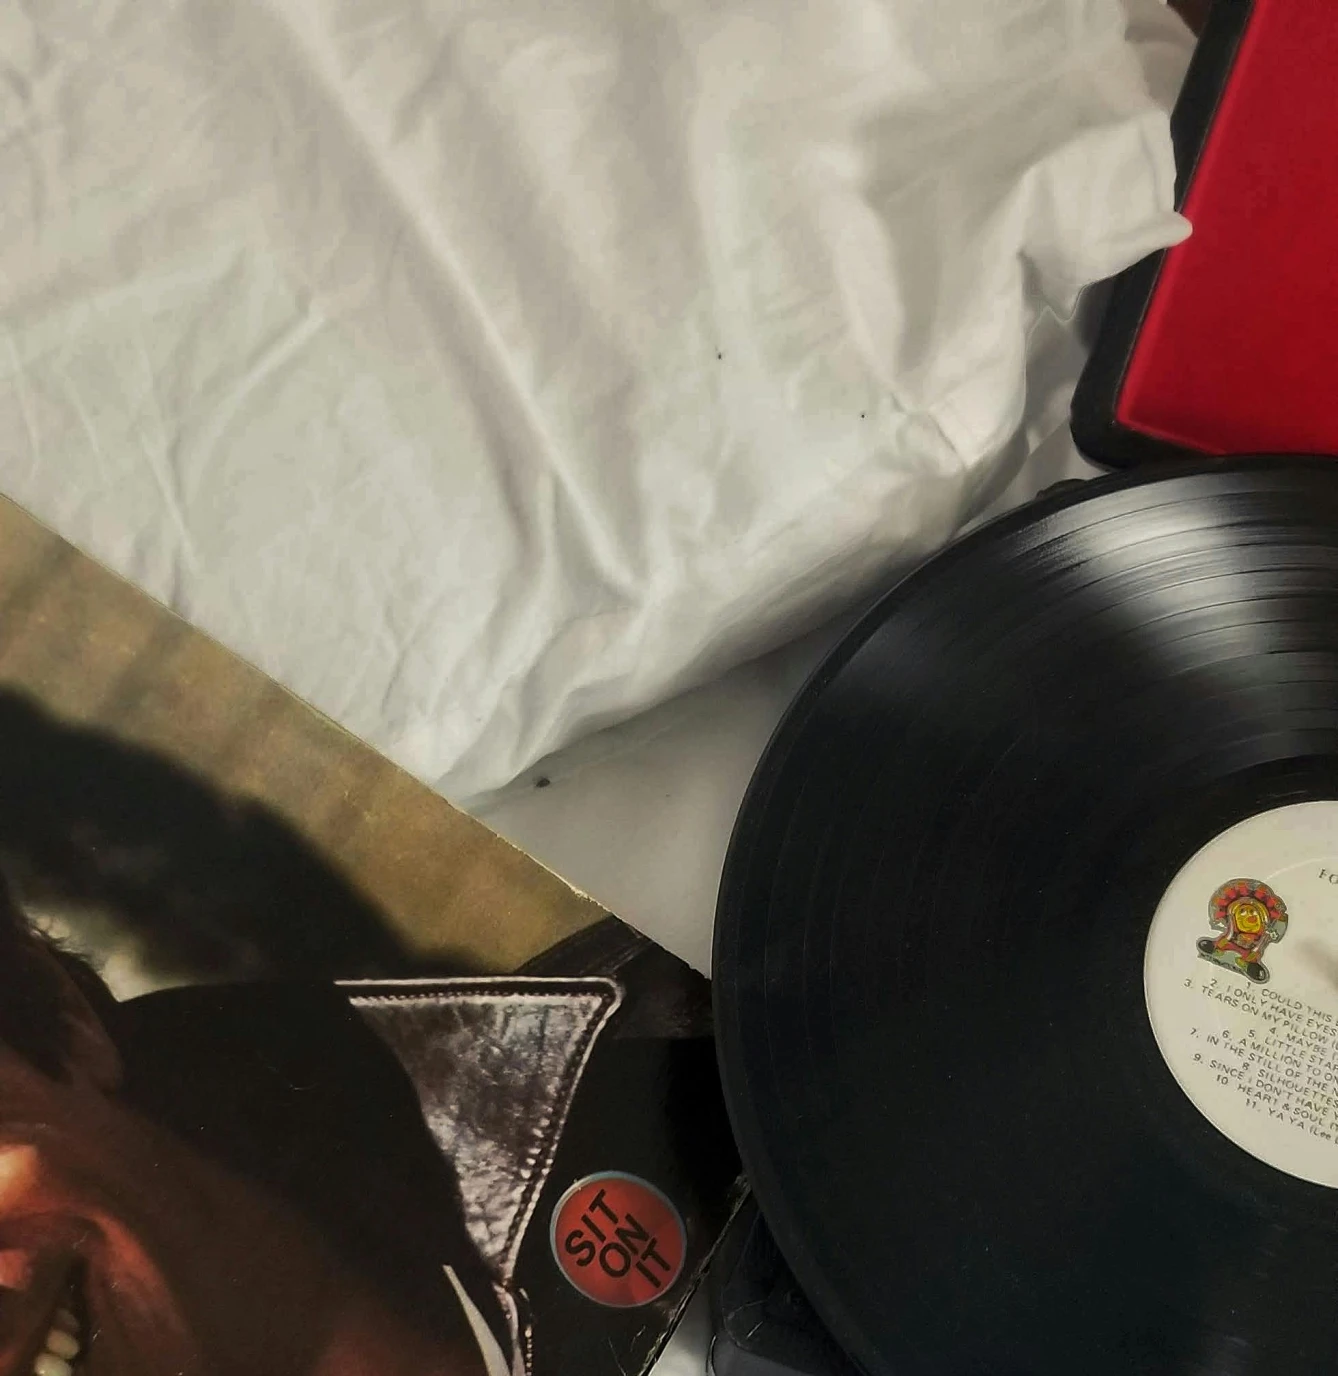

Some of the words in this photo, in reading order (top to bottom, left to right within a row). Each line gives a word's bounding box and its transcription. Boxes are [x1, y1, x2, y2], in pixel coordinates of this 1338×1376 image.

[1202, 985, 1239, 1008] TEARS
[1241, 1003, 1259, 1016] ON
[1262, 1011, 1282, 1024] MY
[1283, 1020, 1327, 1044] PILLOW
[1233, 988, 1267, 1006] ONLY
[1270, 1004, 1303, 1022] HAVE
[1306, 1018, 1337, 1036] EYES
[1261, 988, 1303, 1010] COULD
[1307, 1005, 1332, 1022] THIS
[1206, 1034, 1219, 1046] IN
[1223, 1041, 1245, 1058] THE
[1248, 1052, 1280, 1074] STILL
[1285, 1068, 1302, 1079] OF
[1307, 1076, 1327, 1092] THE
[1239, 1038, 1247, 1047] A
[1250, 1041, 1302, 1069] MILLION
[1306, 1063, 1321, 1077] TO
[1264, 1036, 1306, 1060] LITTLE
[1286, 1033, 1327, 1057] MAYBE
[1209, 1059, 1245, 1081] SINCE
[1295, 1096, 1328, 1116] HAVE
[1237, 1083, 1277, 1106] HEART
[1281, 1102, 1290, 1111] &
[1293, 1107, 1323, 1126] SOUL
[1257, 1068, 1338, 1109] SILHOUETTES
[1268, 1107, 1284, 1122] YA
[1289, 1115, 1305, 1130] YA
[565, 1189, 619, 1267] SIT
[599, 1213, 651, 1278] ON
[635, 1238, 671, 1289] IT
